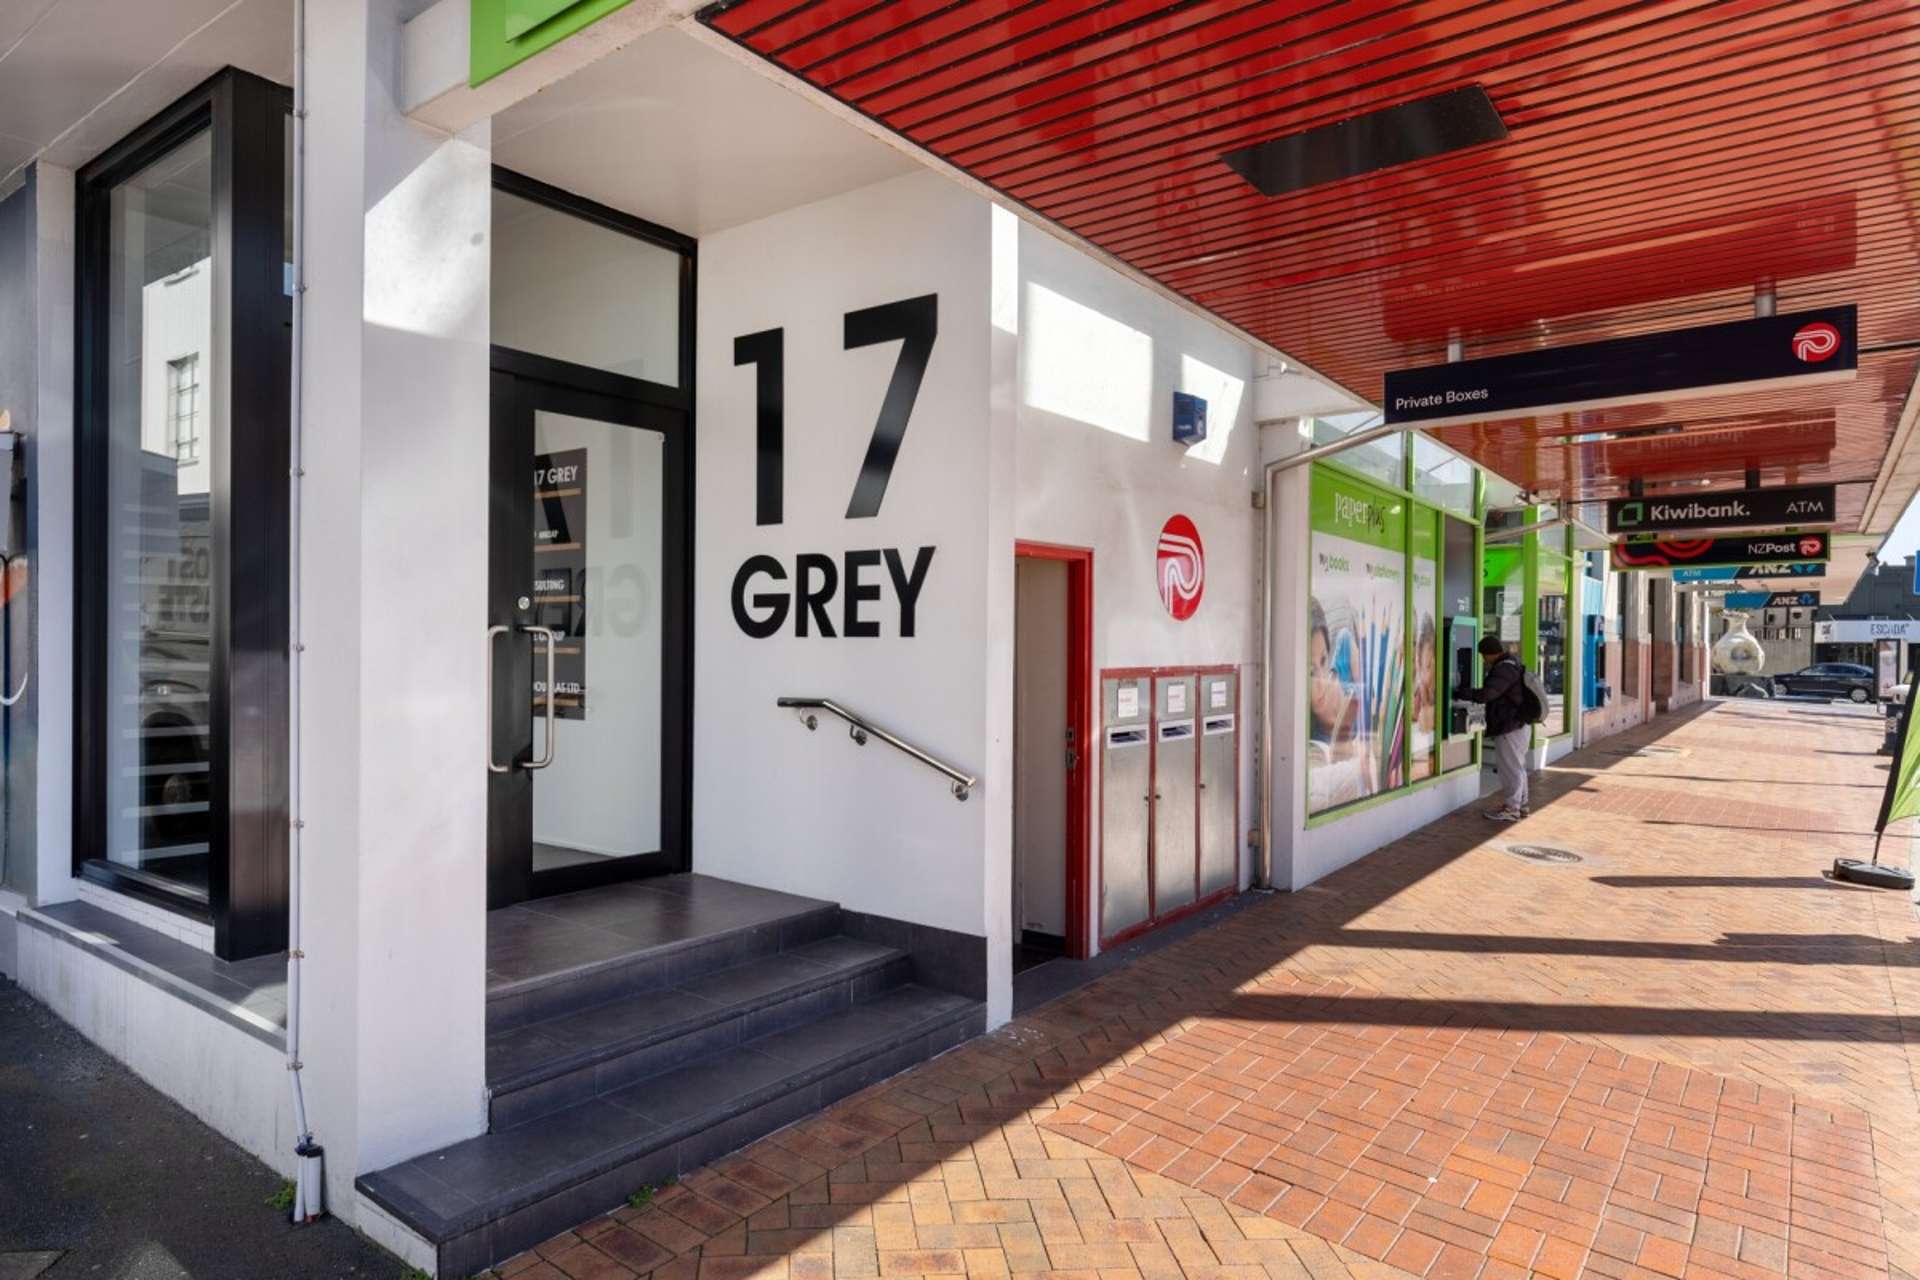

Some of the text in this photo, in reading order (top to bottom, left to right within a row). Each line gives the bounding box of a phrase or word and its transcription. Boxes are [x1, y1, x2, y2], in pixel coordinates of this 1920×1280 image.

[1395, 388, 1488, 410] Private Boxes
[733, 293, 938, 526] 17
[547, 465, 578, 484] GREY
[1786, 500, 1824, 514] ATM
[1748, 564, 1791, 575] ANZ
[731, 546, 936, 639] GREY
[1771, 597, 1798, 606] ANZ
